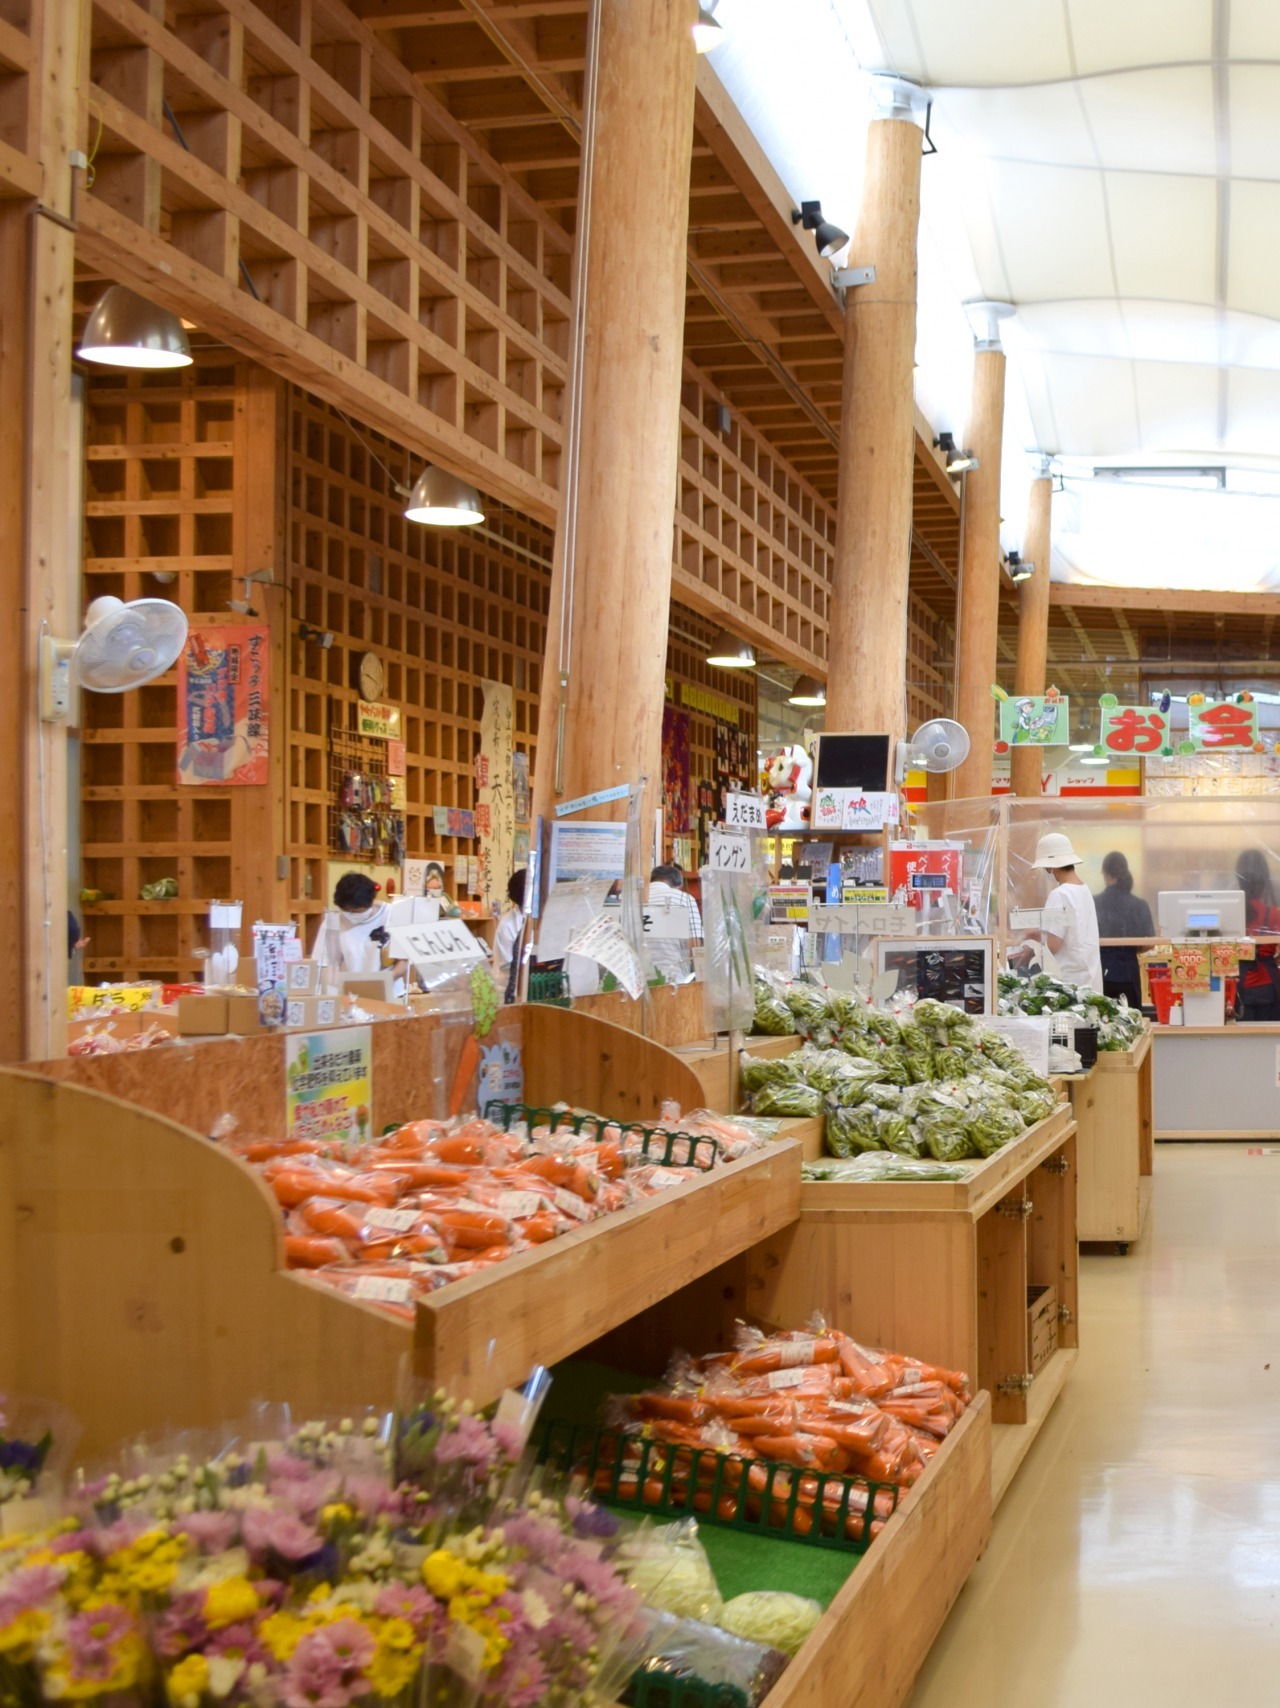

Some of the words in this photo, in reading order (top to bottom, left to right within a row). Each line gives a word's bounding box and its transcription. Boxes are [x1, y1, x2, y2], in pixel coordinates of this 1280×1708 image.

[731, 802, 764, 825] えだまめ
[715, 845, 747, 869] インゲン
[406, 928, 469, 957] にんじん
